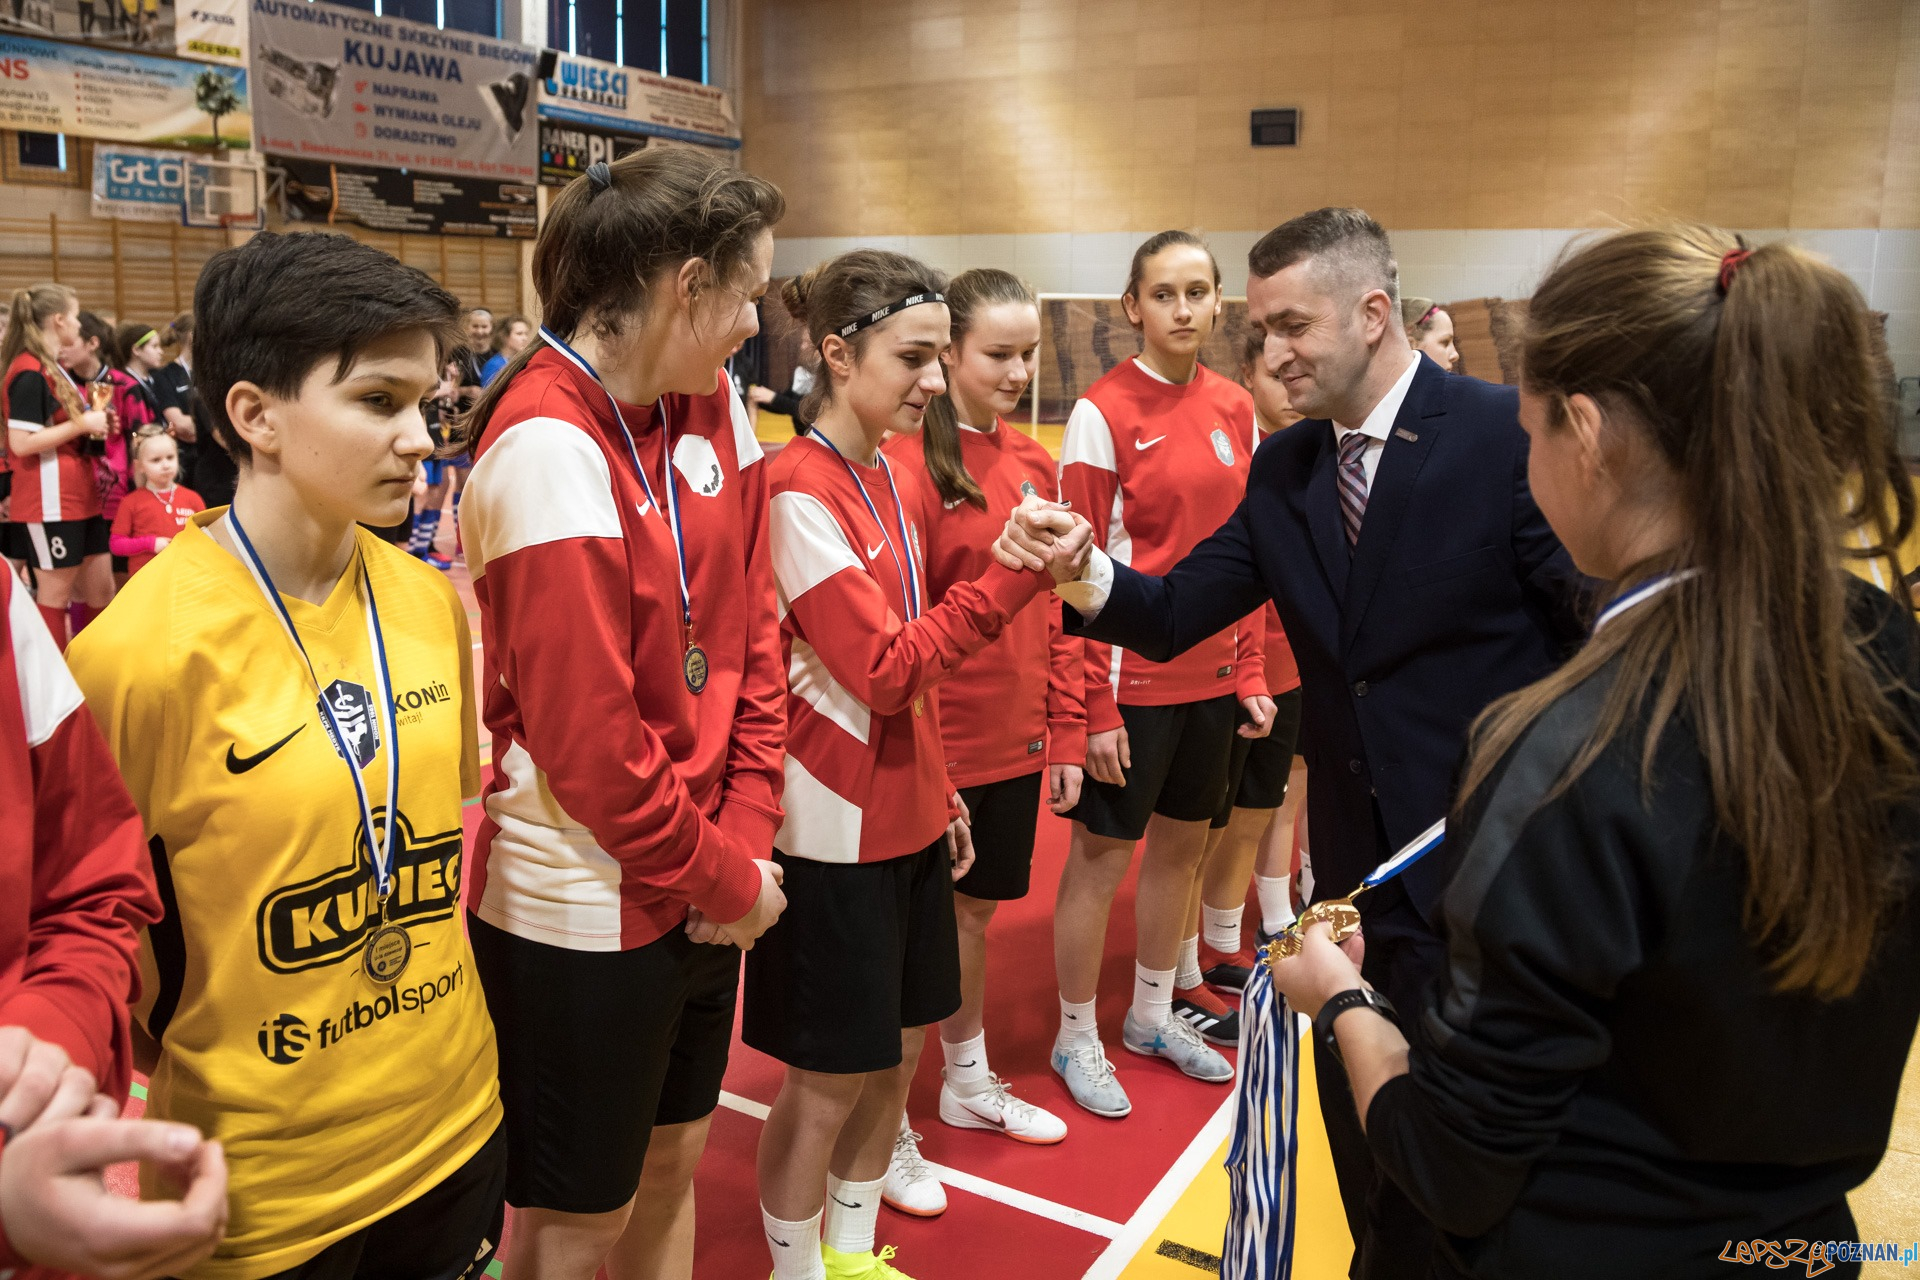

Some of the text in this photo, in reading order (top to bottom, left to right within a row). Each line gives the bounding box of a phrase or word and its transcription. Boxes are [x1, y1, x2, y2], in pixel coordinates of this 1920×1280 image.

[254, 0, 392, 38] AUTOMATYCZNE
[399, 26, 474, 55] SKRZYNIE
[344, 38, 463, 83] KUJAWA
[373, 82, 438, 103] NAPRAWA
[374, 103, 482, 131] WYMIANA OLEJU
[374, 125, 457, 148] DORADZTWO
[841, 321, 858, 338] NIKE
[871, 305, 890, 323] NIKE
[905, 293, 924, 307] NIKE
[51, 536, 67, 559] 8
[291, 853, 459, 949] KUPIEC
